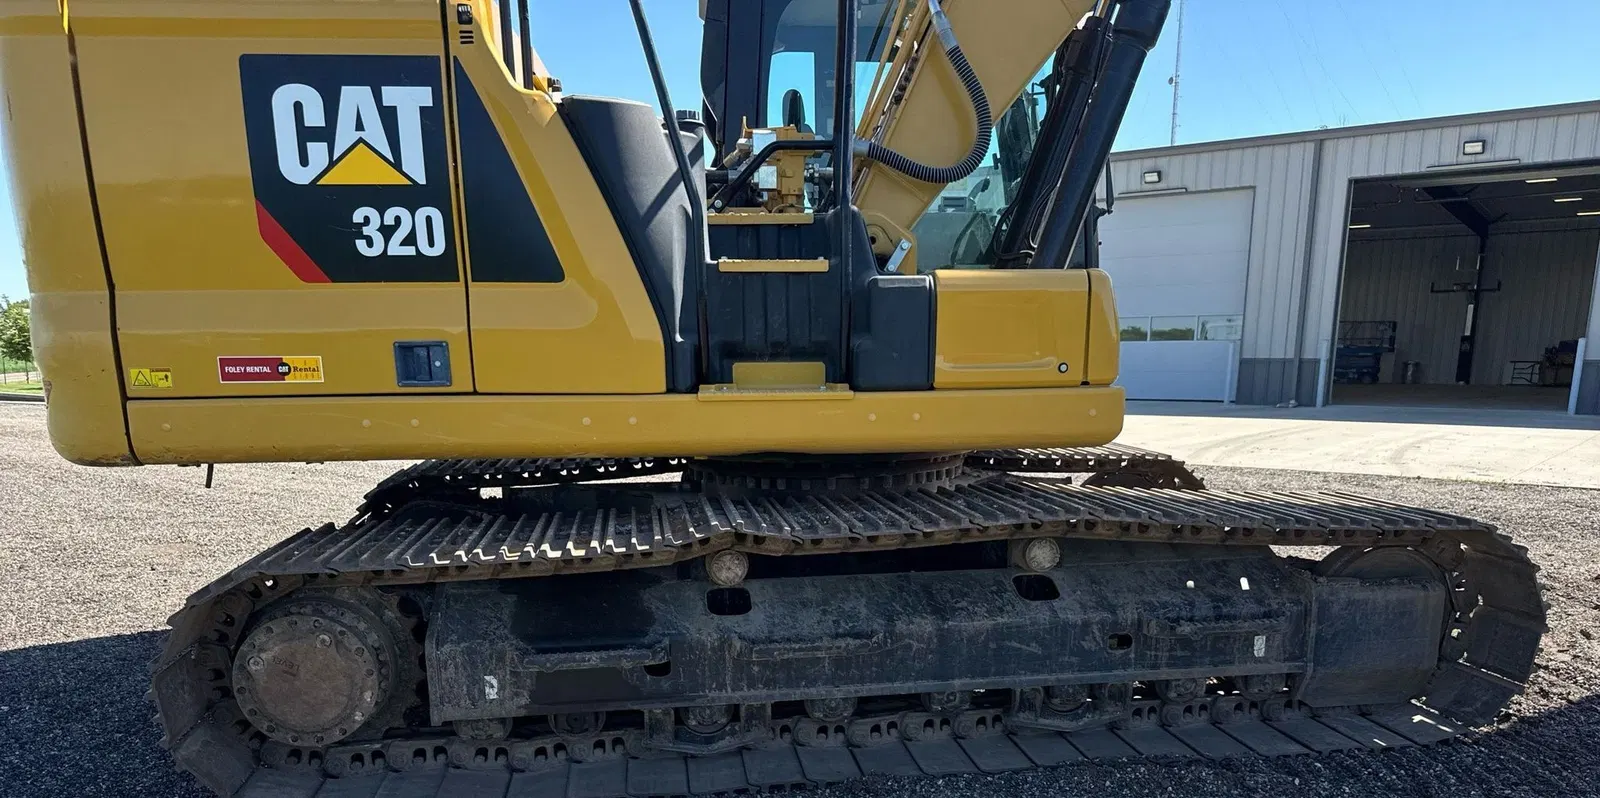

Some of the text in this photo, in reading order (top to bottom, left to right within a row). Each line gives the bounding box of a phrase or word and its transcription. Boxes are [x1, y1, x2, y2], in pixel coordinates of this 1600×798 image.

[271, 83, 433, 185] CAT
[352, 206, 446, 257] 320
[278, 365, 289, 373] CAT
